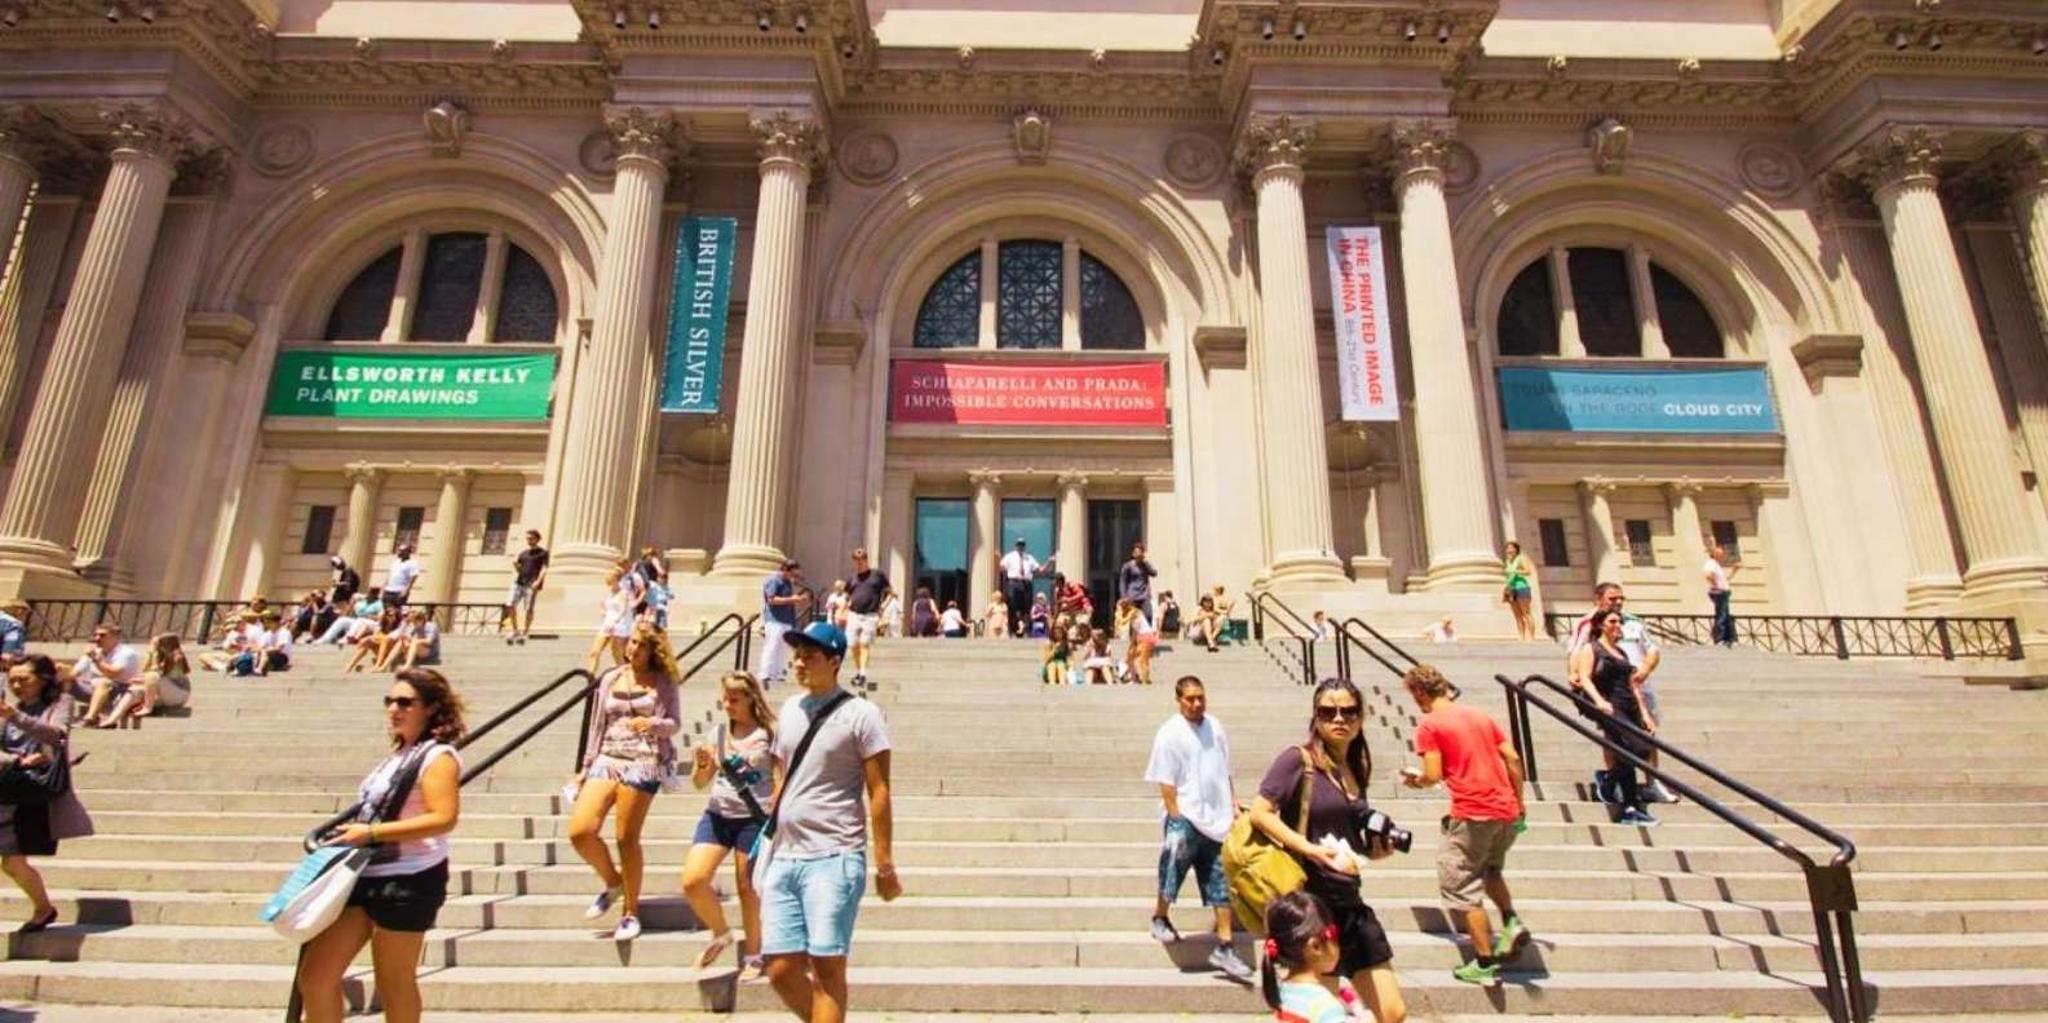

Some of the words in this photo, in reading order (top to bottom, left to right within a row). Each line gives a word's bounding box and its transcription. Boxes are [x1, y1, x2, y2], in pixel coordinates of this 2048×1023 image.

[1337, 238, 1352, 255] IN
[1355, 237, 1370, 267] THE
[691, 228, 719, 318] BRITISH
[1340, 258, 1356, 314] CHINA
[1358, 273, 1376, 344] PRINTED
[301, 366, 444, 383] ELLSWORTH
[456, 368, 531, 384] KELLY
[681, 327, 709, 405] SILVER
[1365, 350, 1383, 406] IMAGE
[296, 387, 363, 403] PLANT
[368, 388, 478, 404] DRAWINGS
[911, 376, 1036, 390] SCHIAPARELLI
[1045, 376, 1077, 390] AND
[1084, 377, 1147, 391] PRADA:
[904, 394, 1008, 409] IMPOSSIBLE
[1013, 395, 1154, 410] CONVERSATIONS
[1664, 403, 1720, 416] CLOUD
[1726, 403, 1763, 416] CITY
